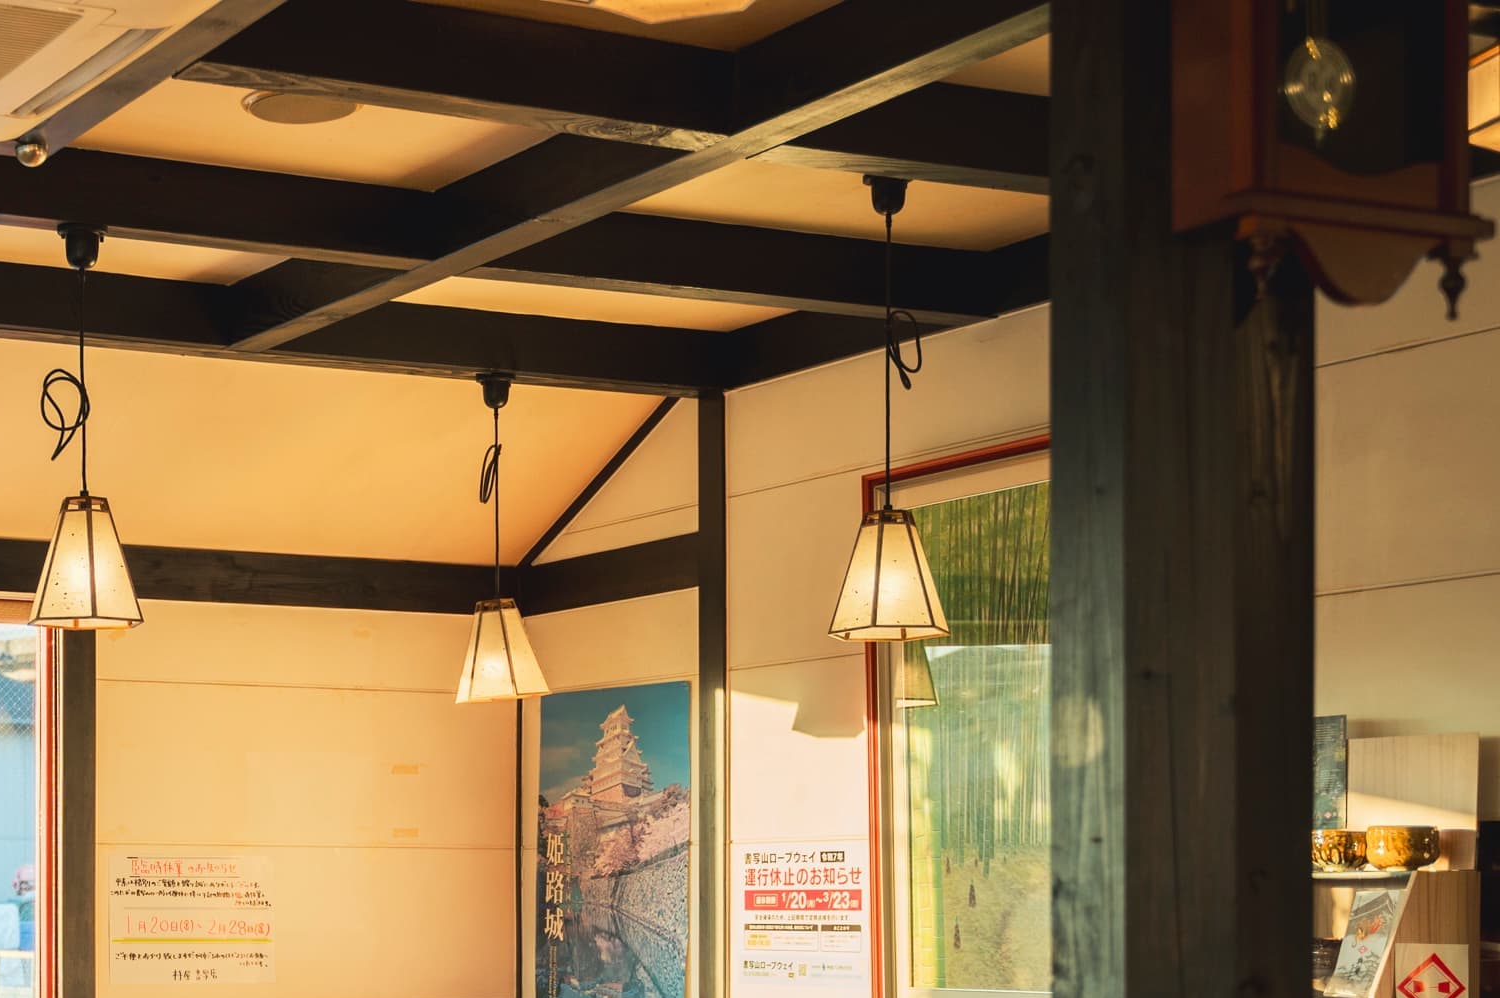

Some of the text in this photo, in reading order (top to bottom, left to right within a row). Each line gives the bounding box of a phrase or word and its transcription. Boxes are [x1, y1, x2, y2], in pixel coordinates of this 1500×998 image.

[544, 833, 564, 942] 姫路城
[744, 866, 862, 887] 運行休止のお知らせ
